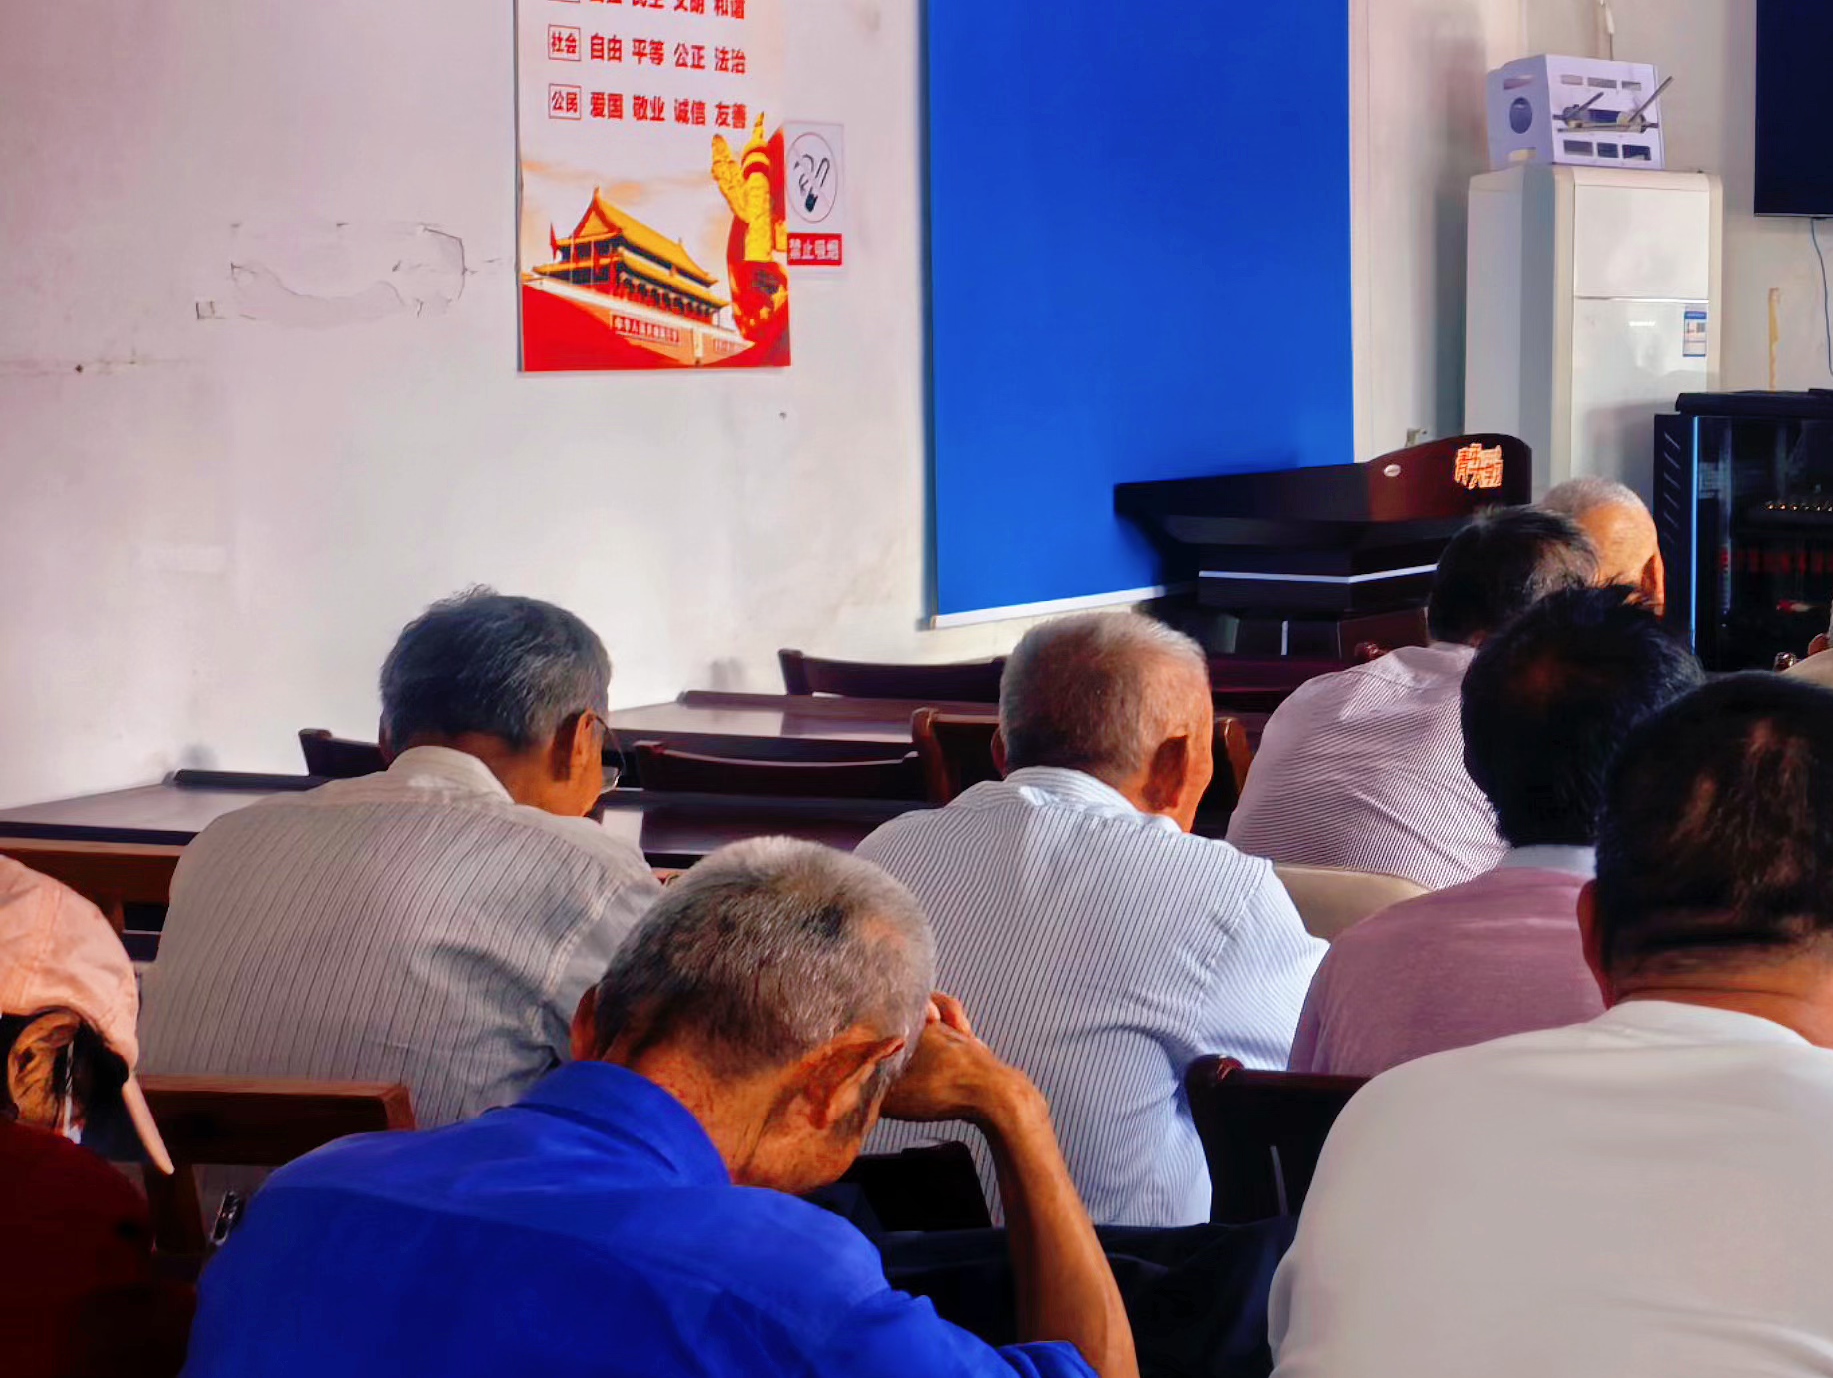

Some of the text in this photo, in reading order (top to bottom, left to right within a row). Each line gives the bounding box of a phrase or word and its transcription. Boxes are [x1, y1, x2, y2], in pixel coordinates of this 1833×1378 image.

[551, 31, 747, 75] 社会 自由 平等 公正 法治
[551, 90, 748, 130] 公民 爱国 敬业 诚信 友善
